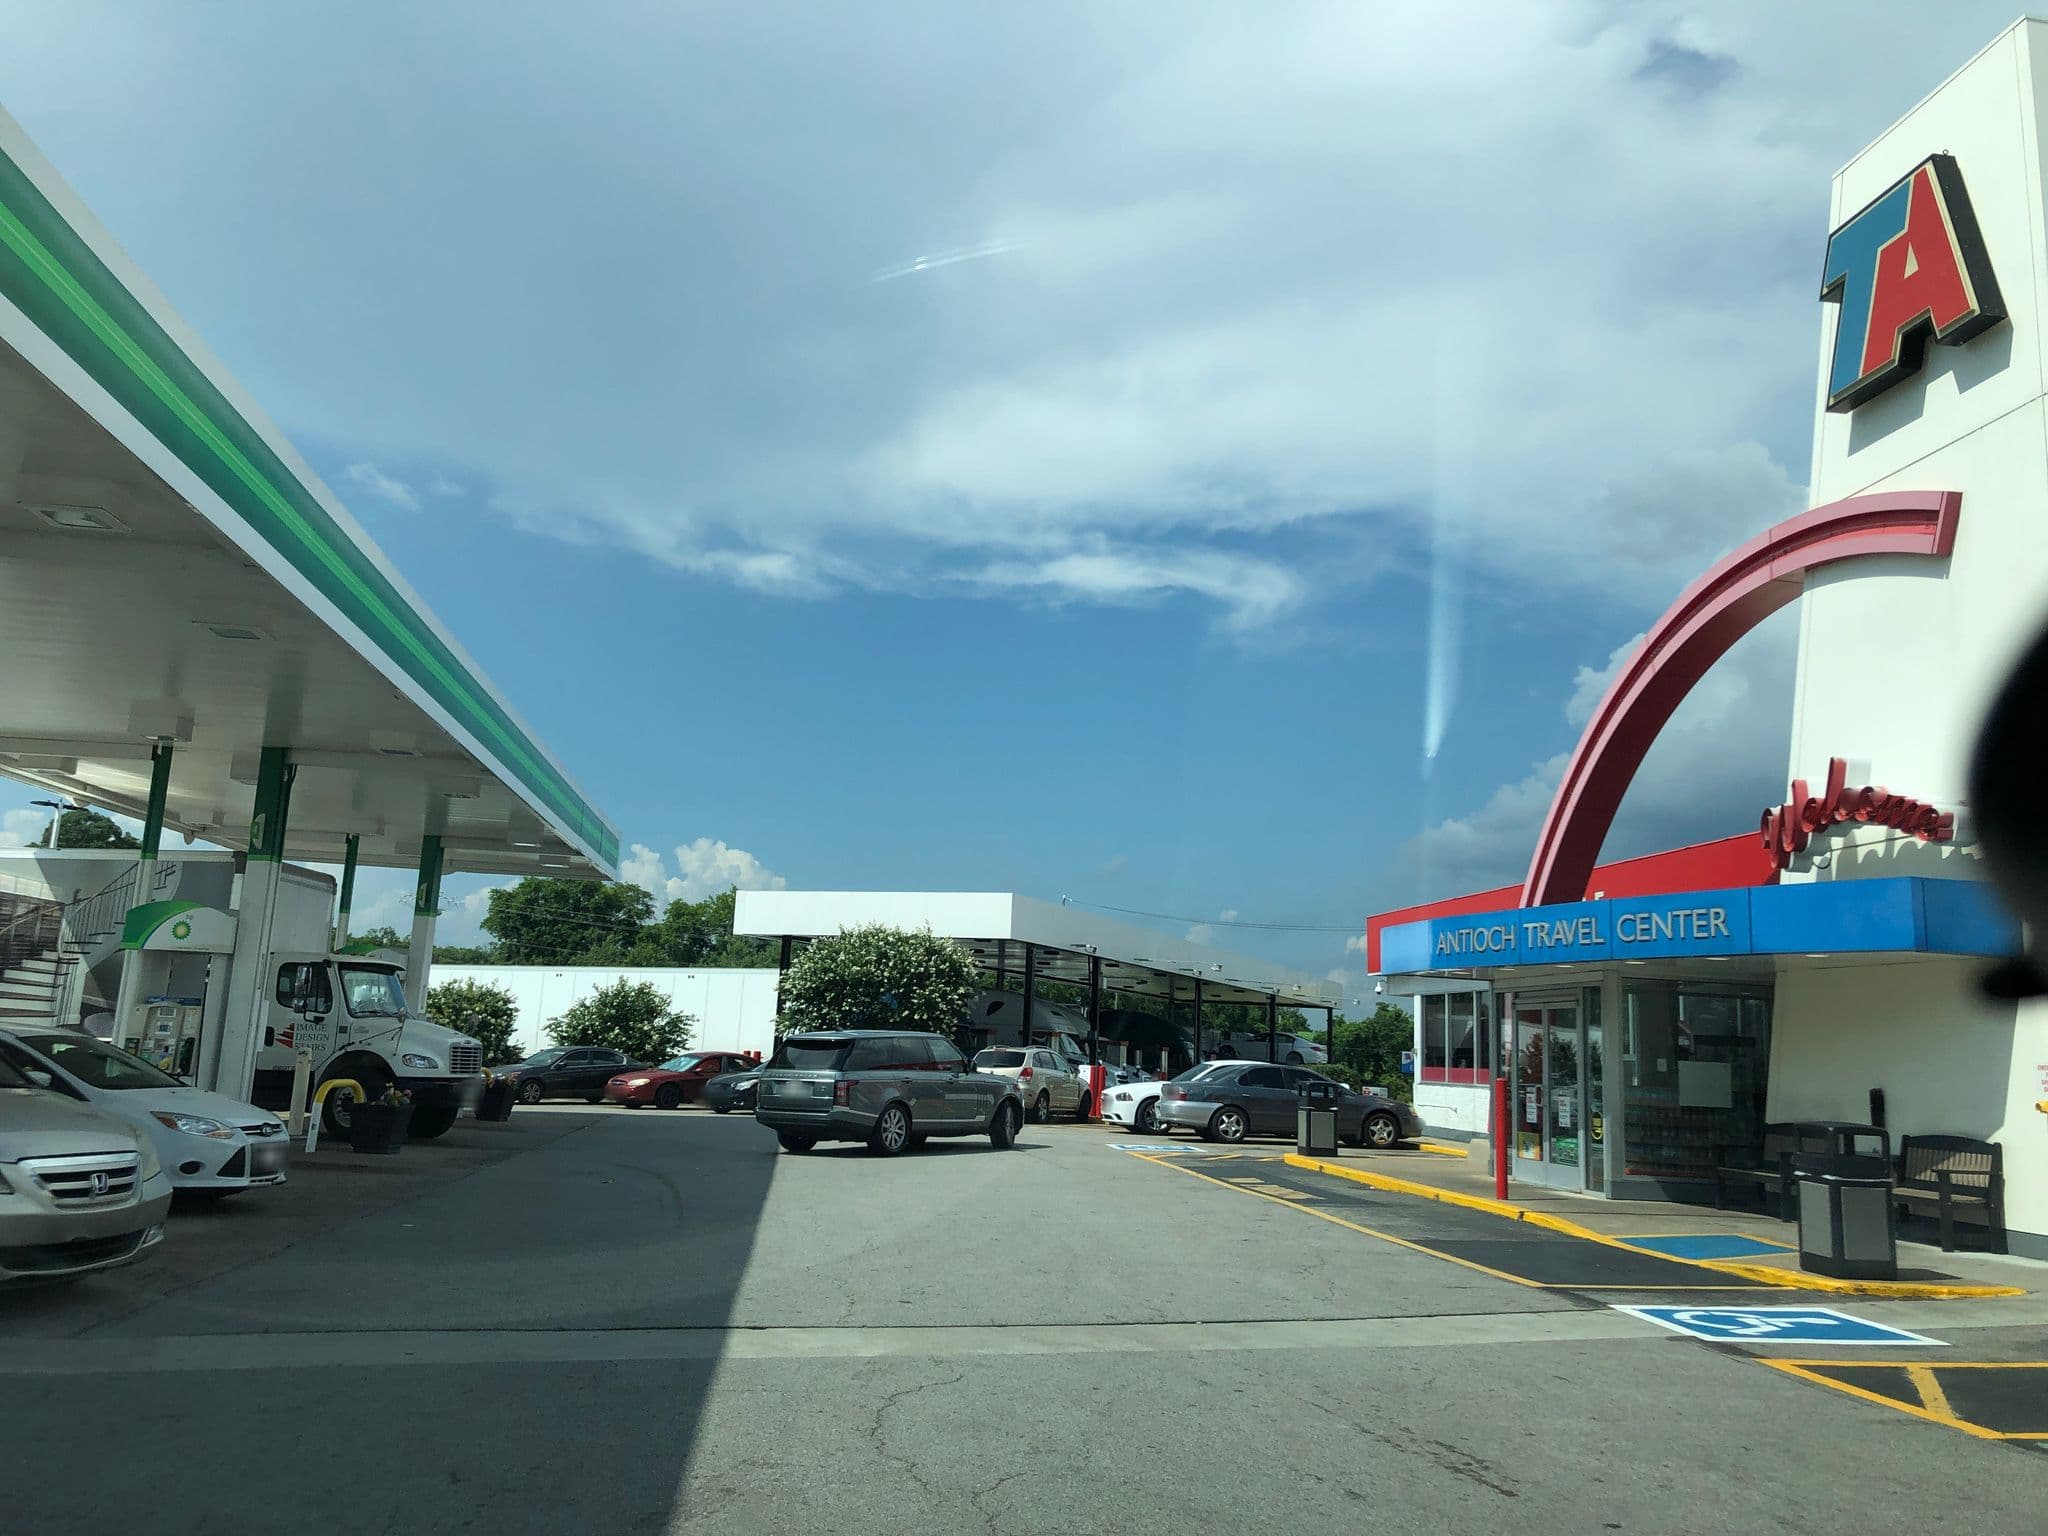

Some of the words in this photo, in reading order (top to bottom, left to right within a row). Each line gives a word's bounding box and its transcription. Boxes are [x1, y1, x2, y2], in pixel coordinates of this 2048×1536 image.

[1823, 157, 1982, 405] TA
[1436, 925, 1516, 955] ANTIOCH
[1523, 917, 1605, 949] TRAVEL
[1616, 907, 1730, 943] CENTER
[295, 1033, 329, 1041] DESIGN
[296, 1023, 327, 1032] IMAGE
